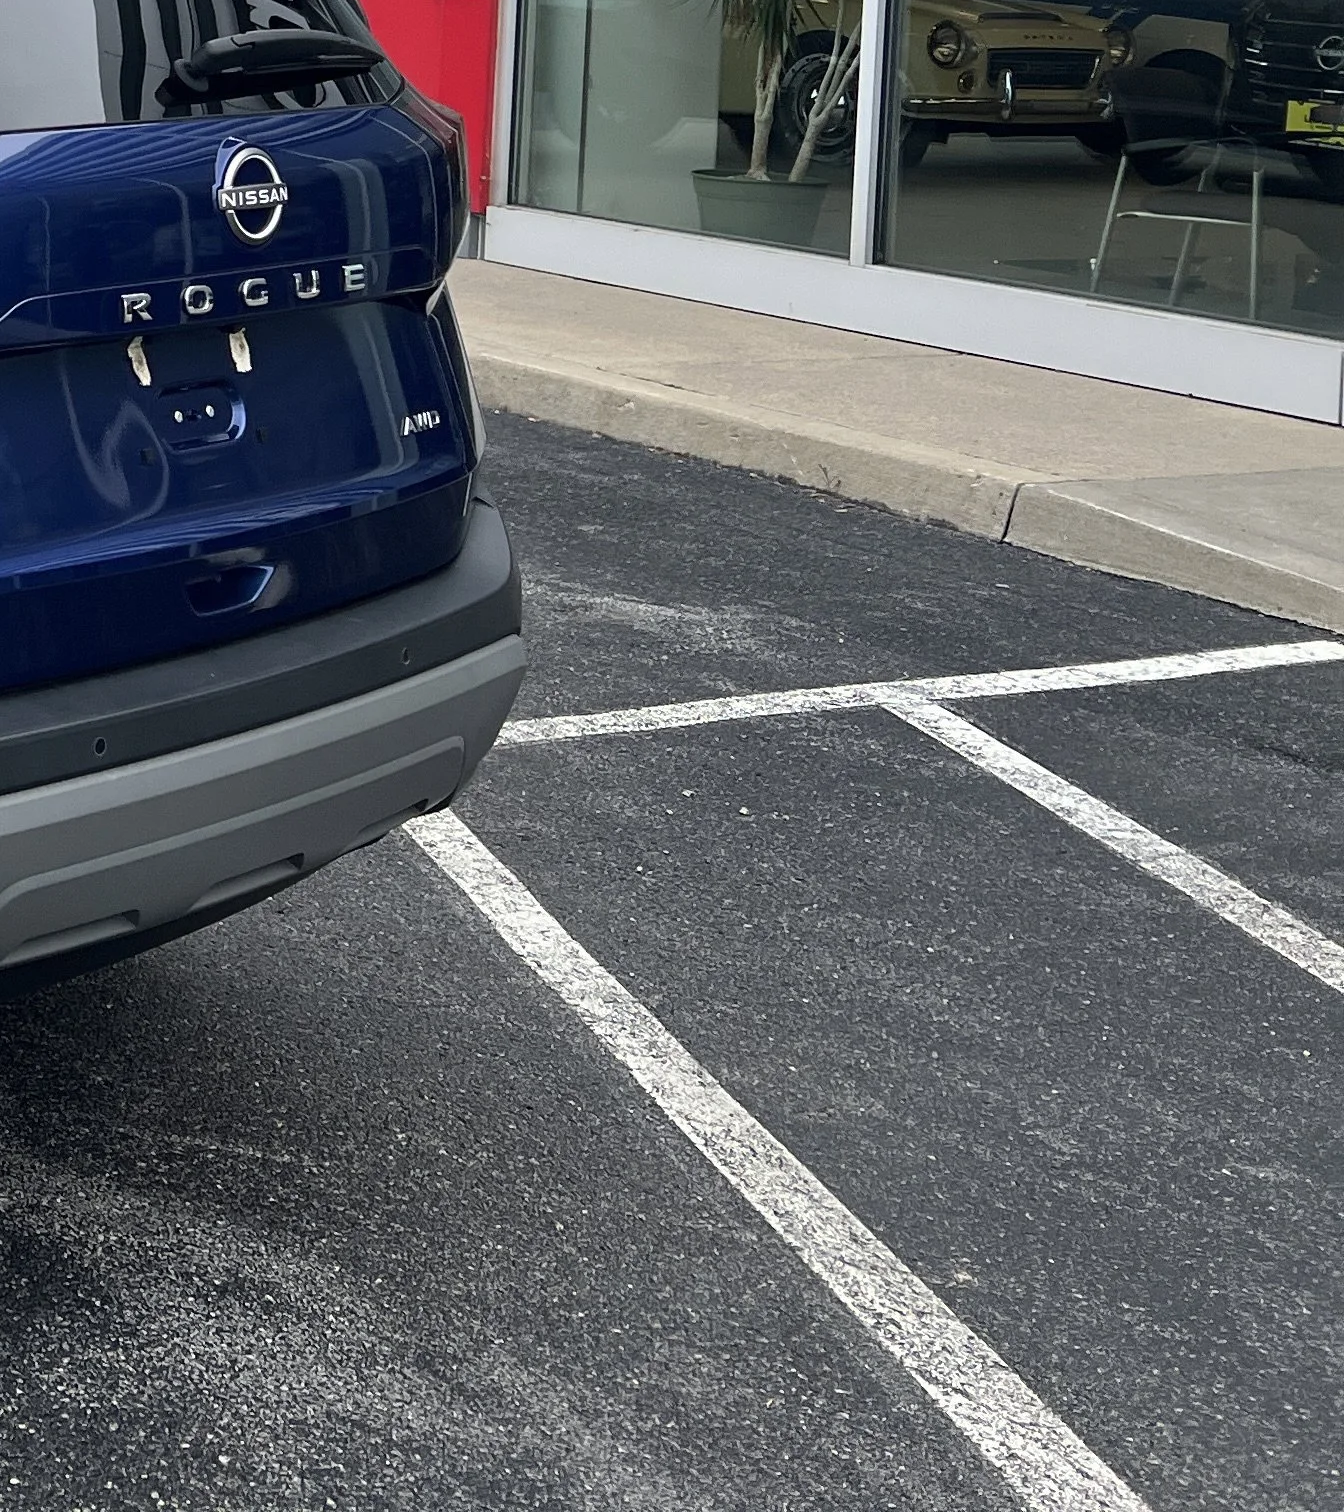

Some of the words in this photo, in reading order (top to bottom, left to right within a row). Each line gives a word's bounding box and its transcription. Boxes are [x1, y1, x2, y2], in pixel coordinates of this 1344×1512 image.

[221, 187, 289, 208] NISSAN
[120, 263, 366, 324] ROGUE
[401, 410, 440, 436] AWD
